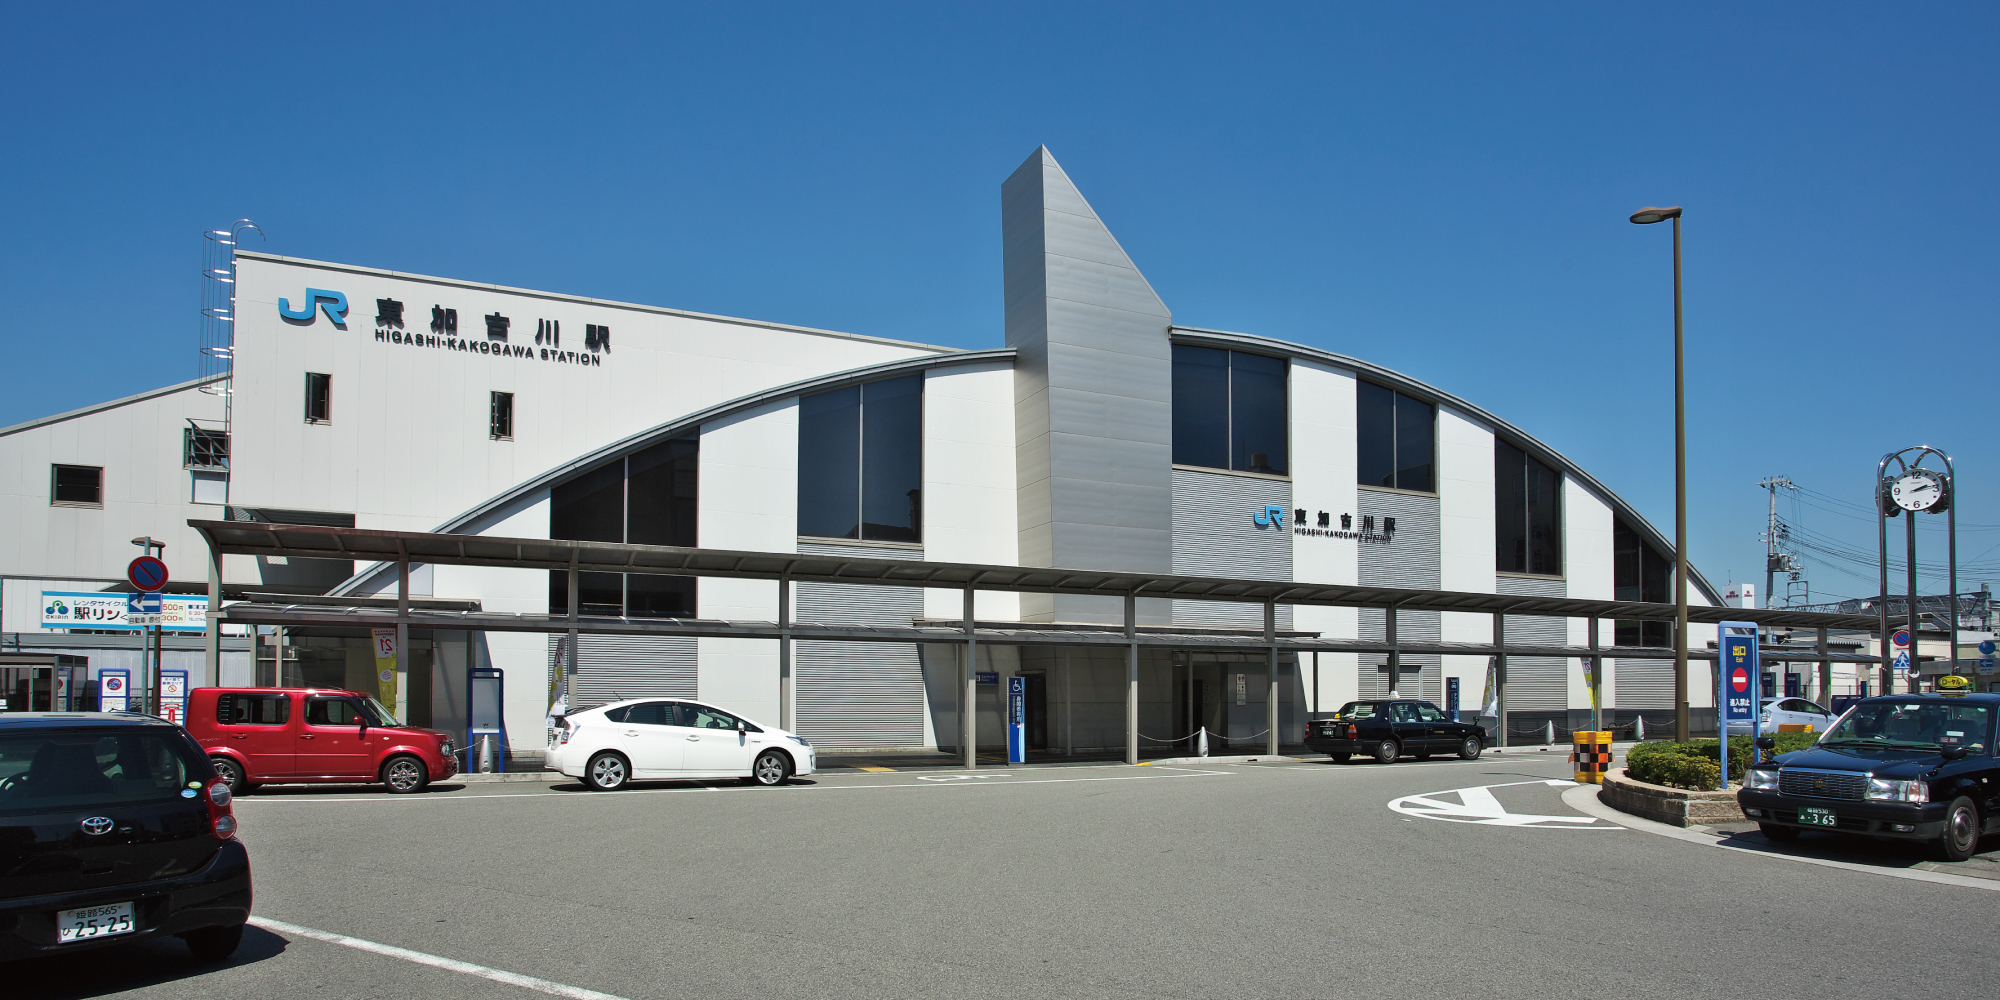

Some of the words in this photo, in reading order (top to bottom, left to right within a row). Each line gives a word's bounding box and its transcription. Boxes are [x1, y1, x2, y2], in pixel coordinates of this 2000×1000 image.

[278, 287, 348, 325] JR
[375, 297, 611, 351] 東加古川駅
[375, 329, 534, 360] HIGASHI-KAKOGAWA
[540, 348, 600, 367] STATION
[1911, 471, 1921, 479] 12
[1893, 487, 1900, 495] 9
[1254, 505, 1283, 526] JR
[1294, 508, 1396, 532] 東加古川駅
[1733, 645, 1746, 656] 出口
[76, 906, 118, 919] 姫路565
[75, 914, 130, 938] 25-25
